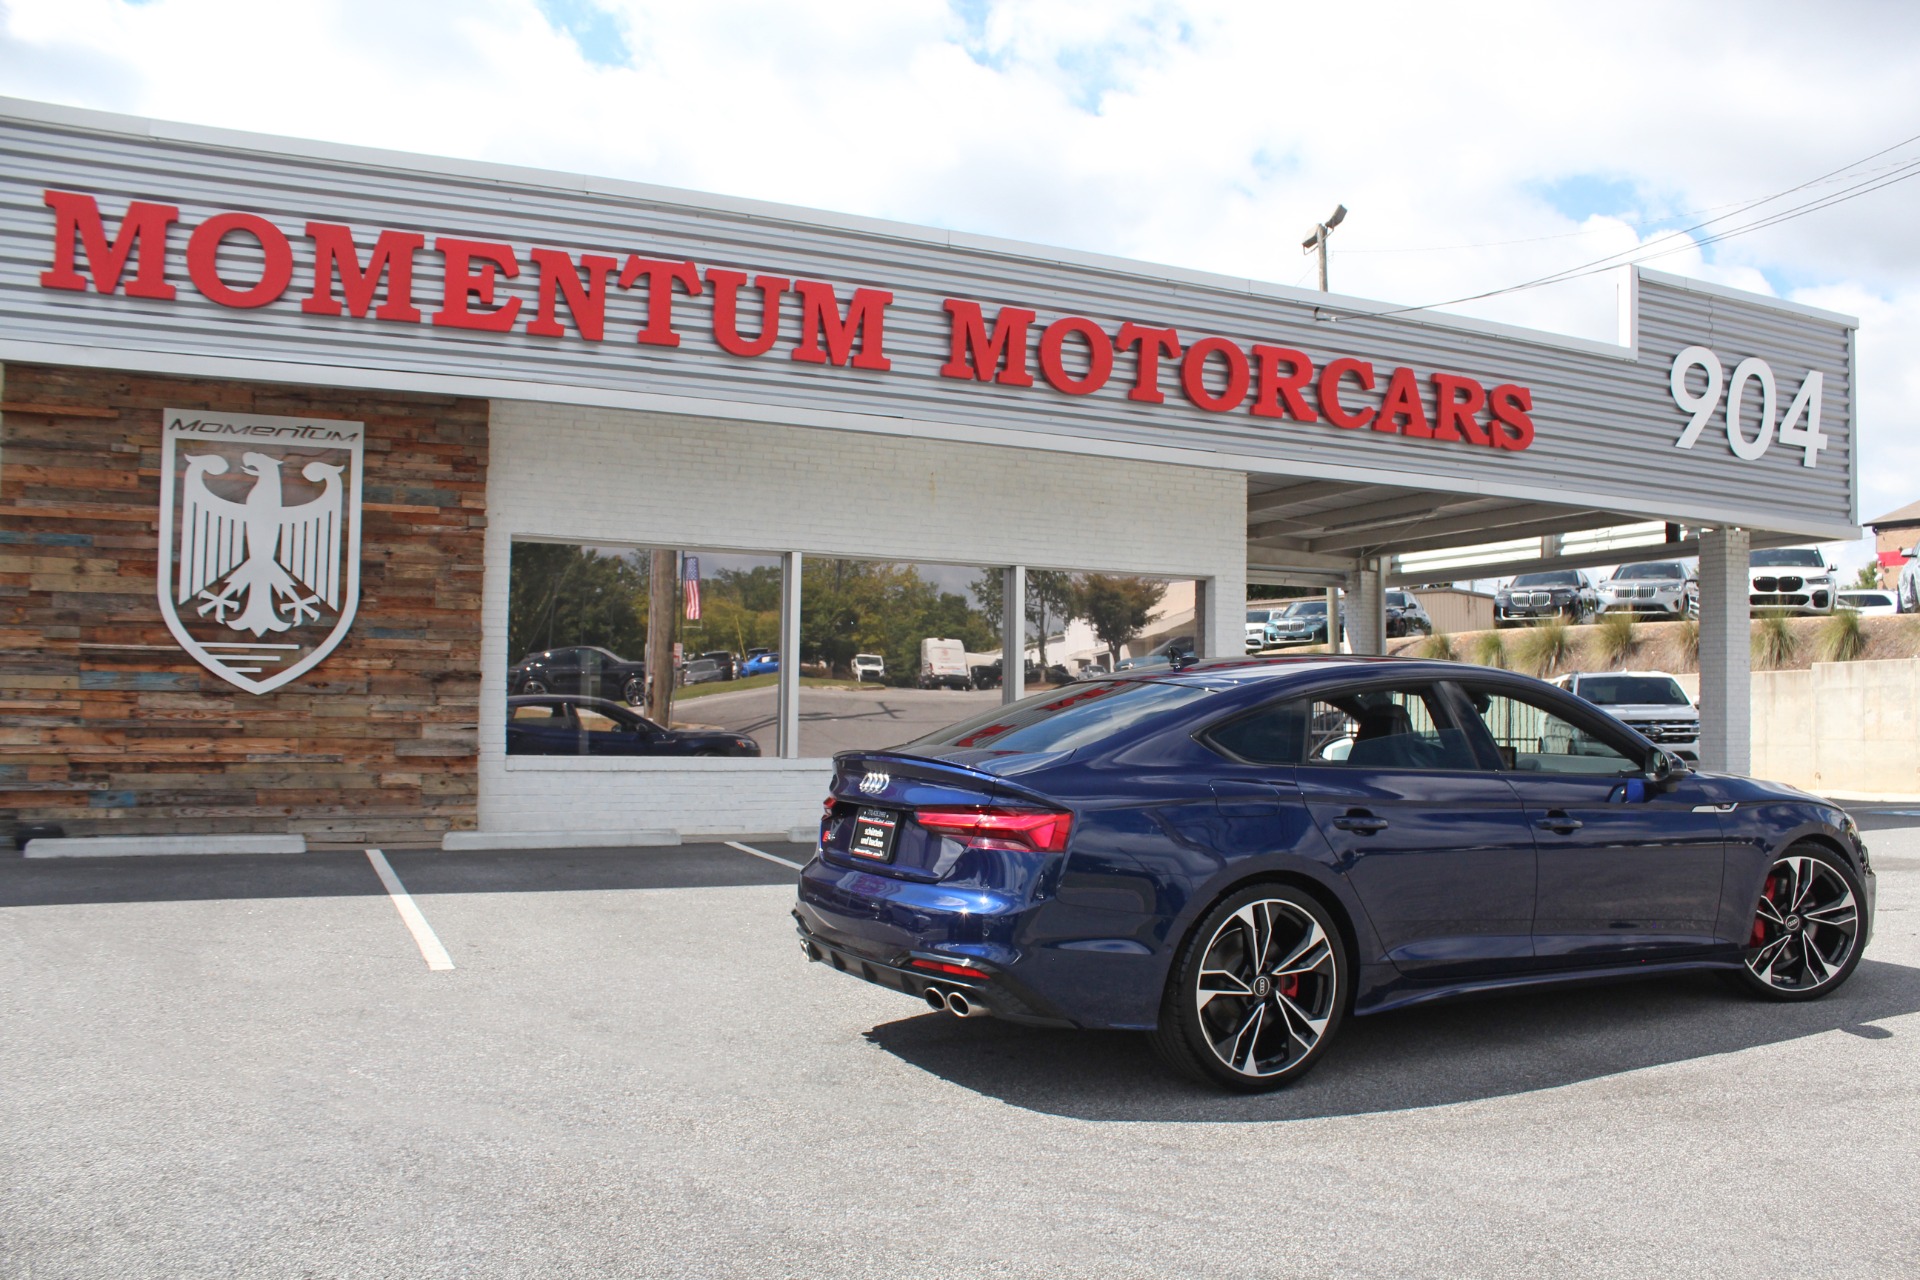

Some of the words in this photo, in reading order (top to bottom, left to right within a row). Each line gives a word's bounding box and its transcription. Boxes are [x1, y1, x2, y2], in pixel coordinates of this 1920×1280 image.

[40, 189, 894, 372] MOMENTUM
[940, 298, 1535, 452] MOTORCARS
[1670, 345, 1828, 468] 904
